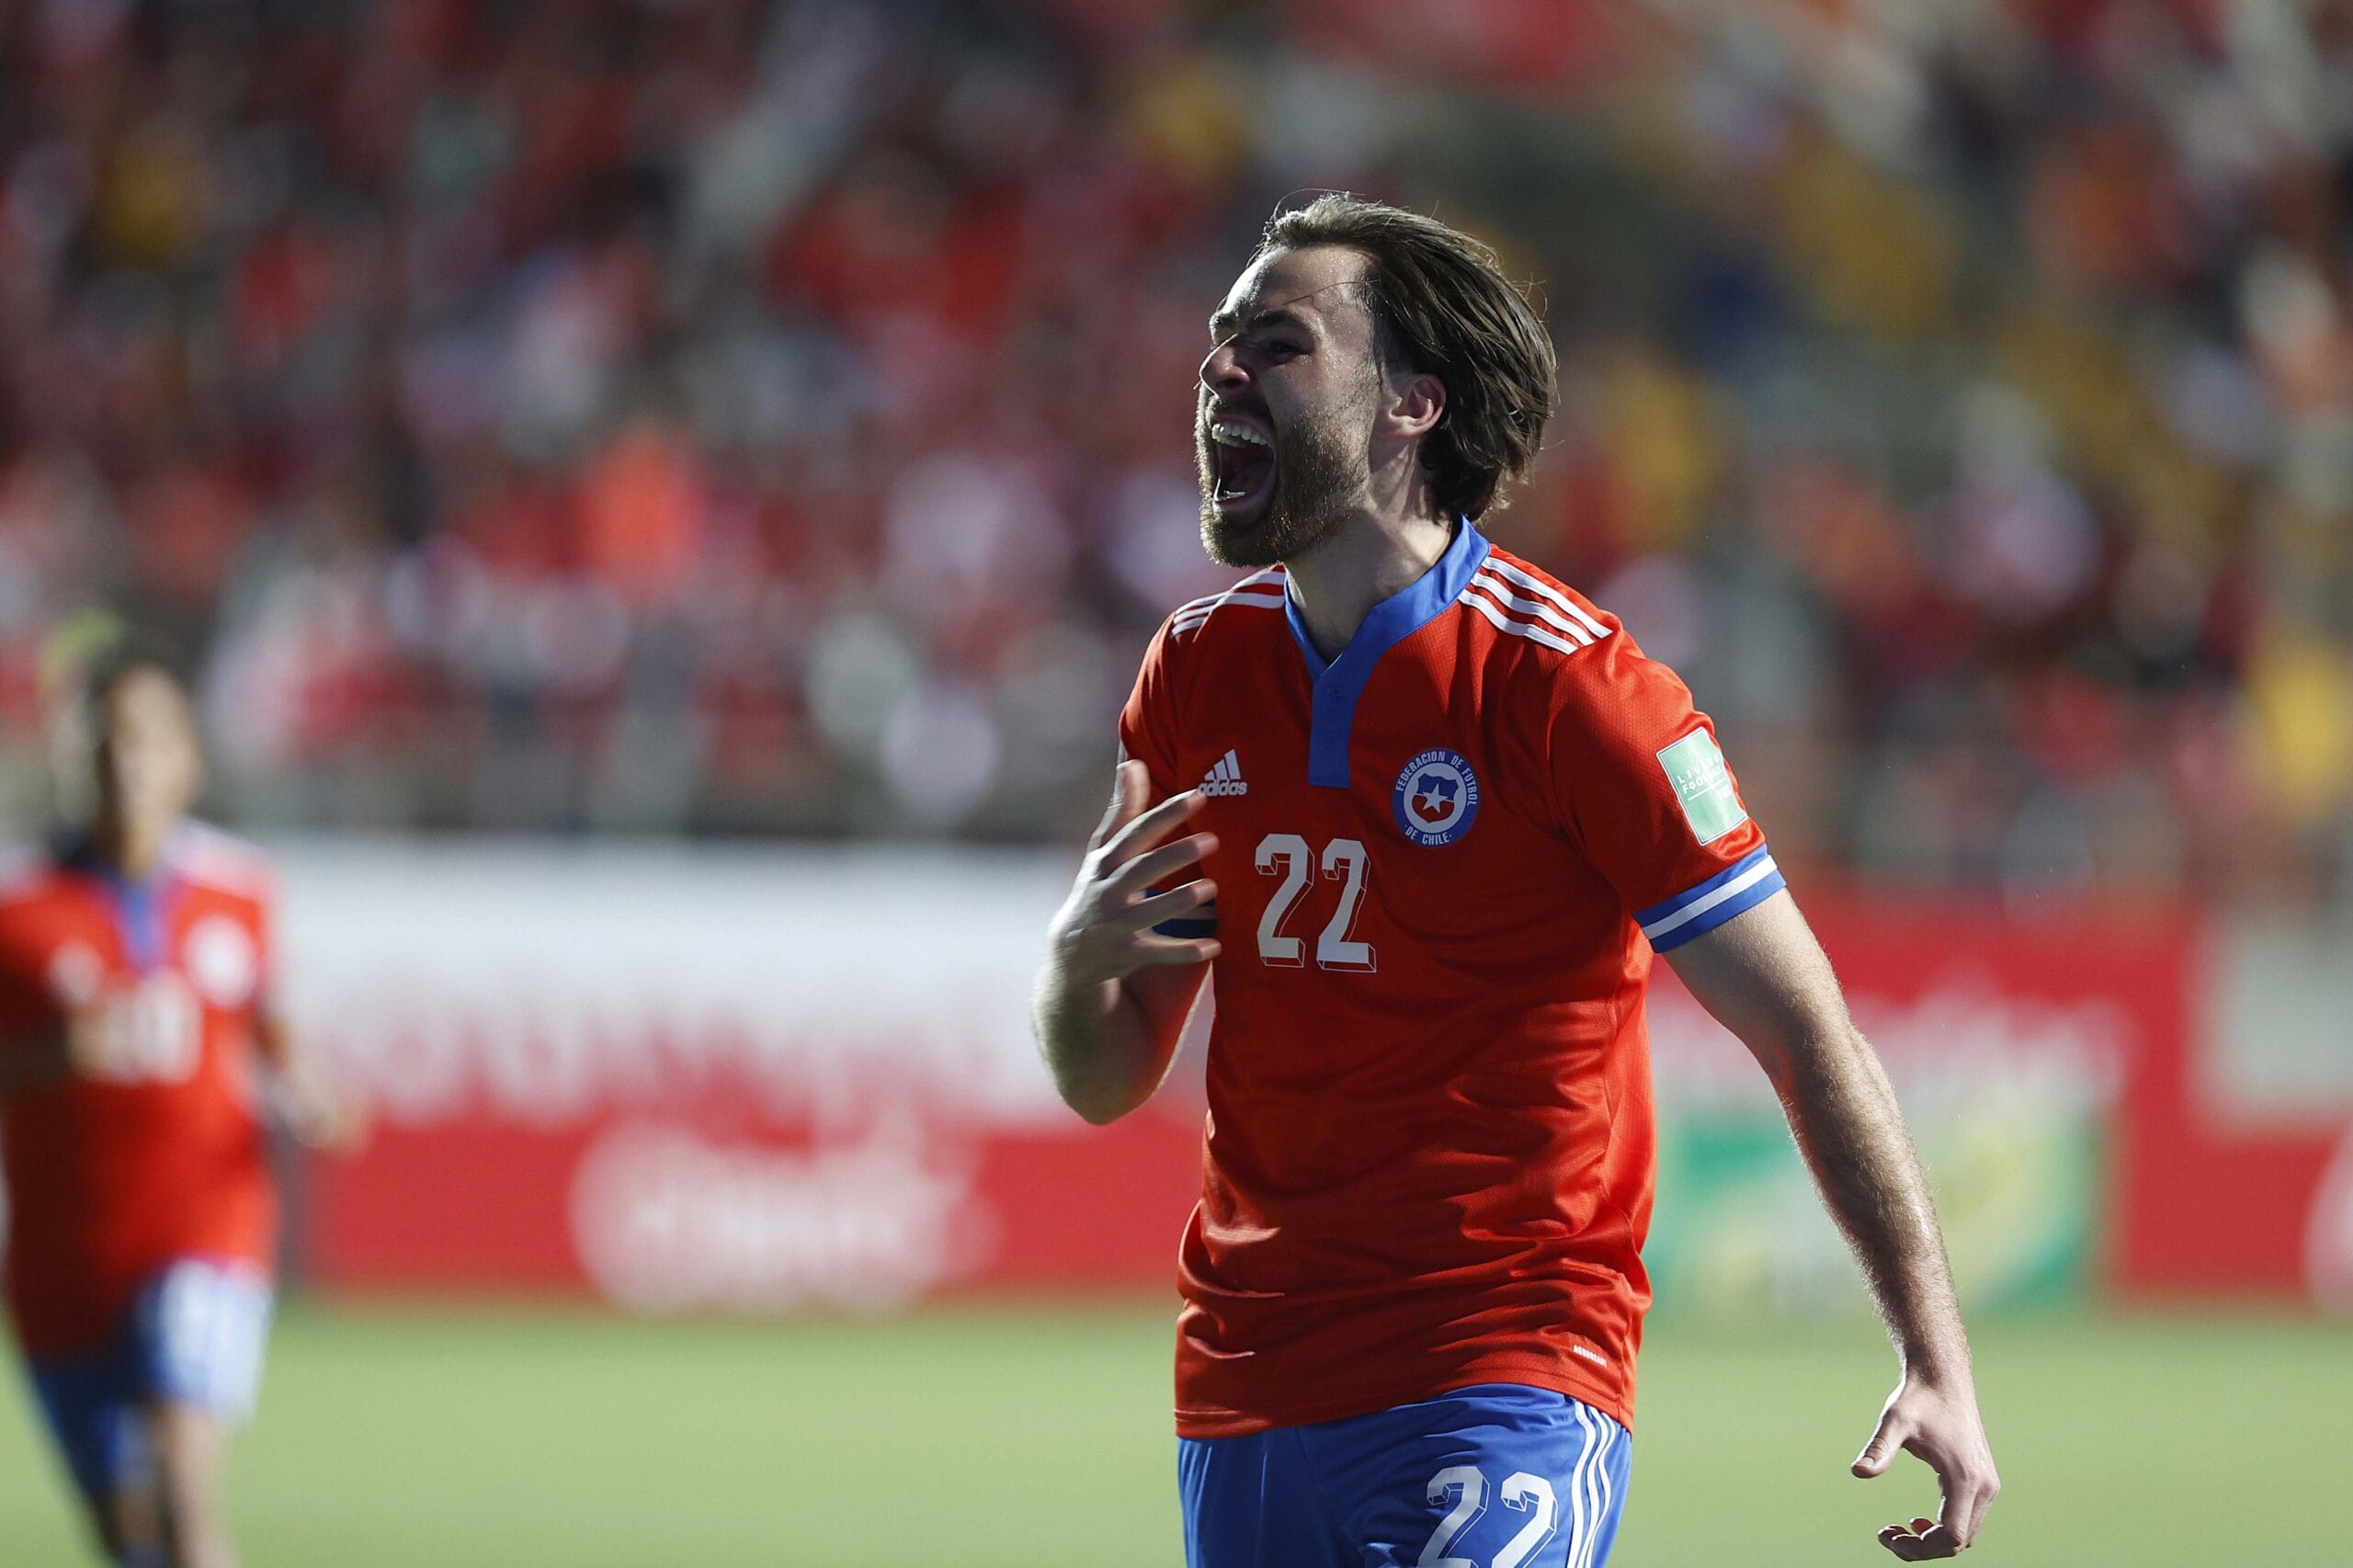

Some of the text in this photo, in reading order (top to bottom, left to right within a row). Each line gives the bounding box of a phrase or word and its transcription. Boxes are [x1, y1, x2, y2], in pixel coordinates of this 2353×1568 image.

[1198, 778, 1247, 797] adidas
[1395, 751, 1478, 806] FEDERACION DE FUTBOL
[1255, 833, 1377, 972] 22
[1416, 1465, 1558, 1568] 22
